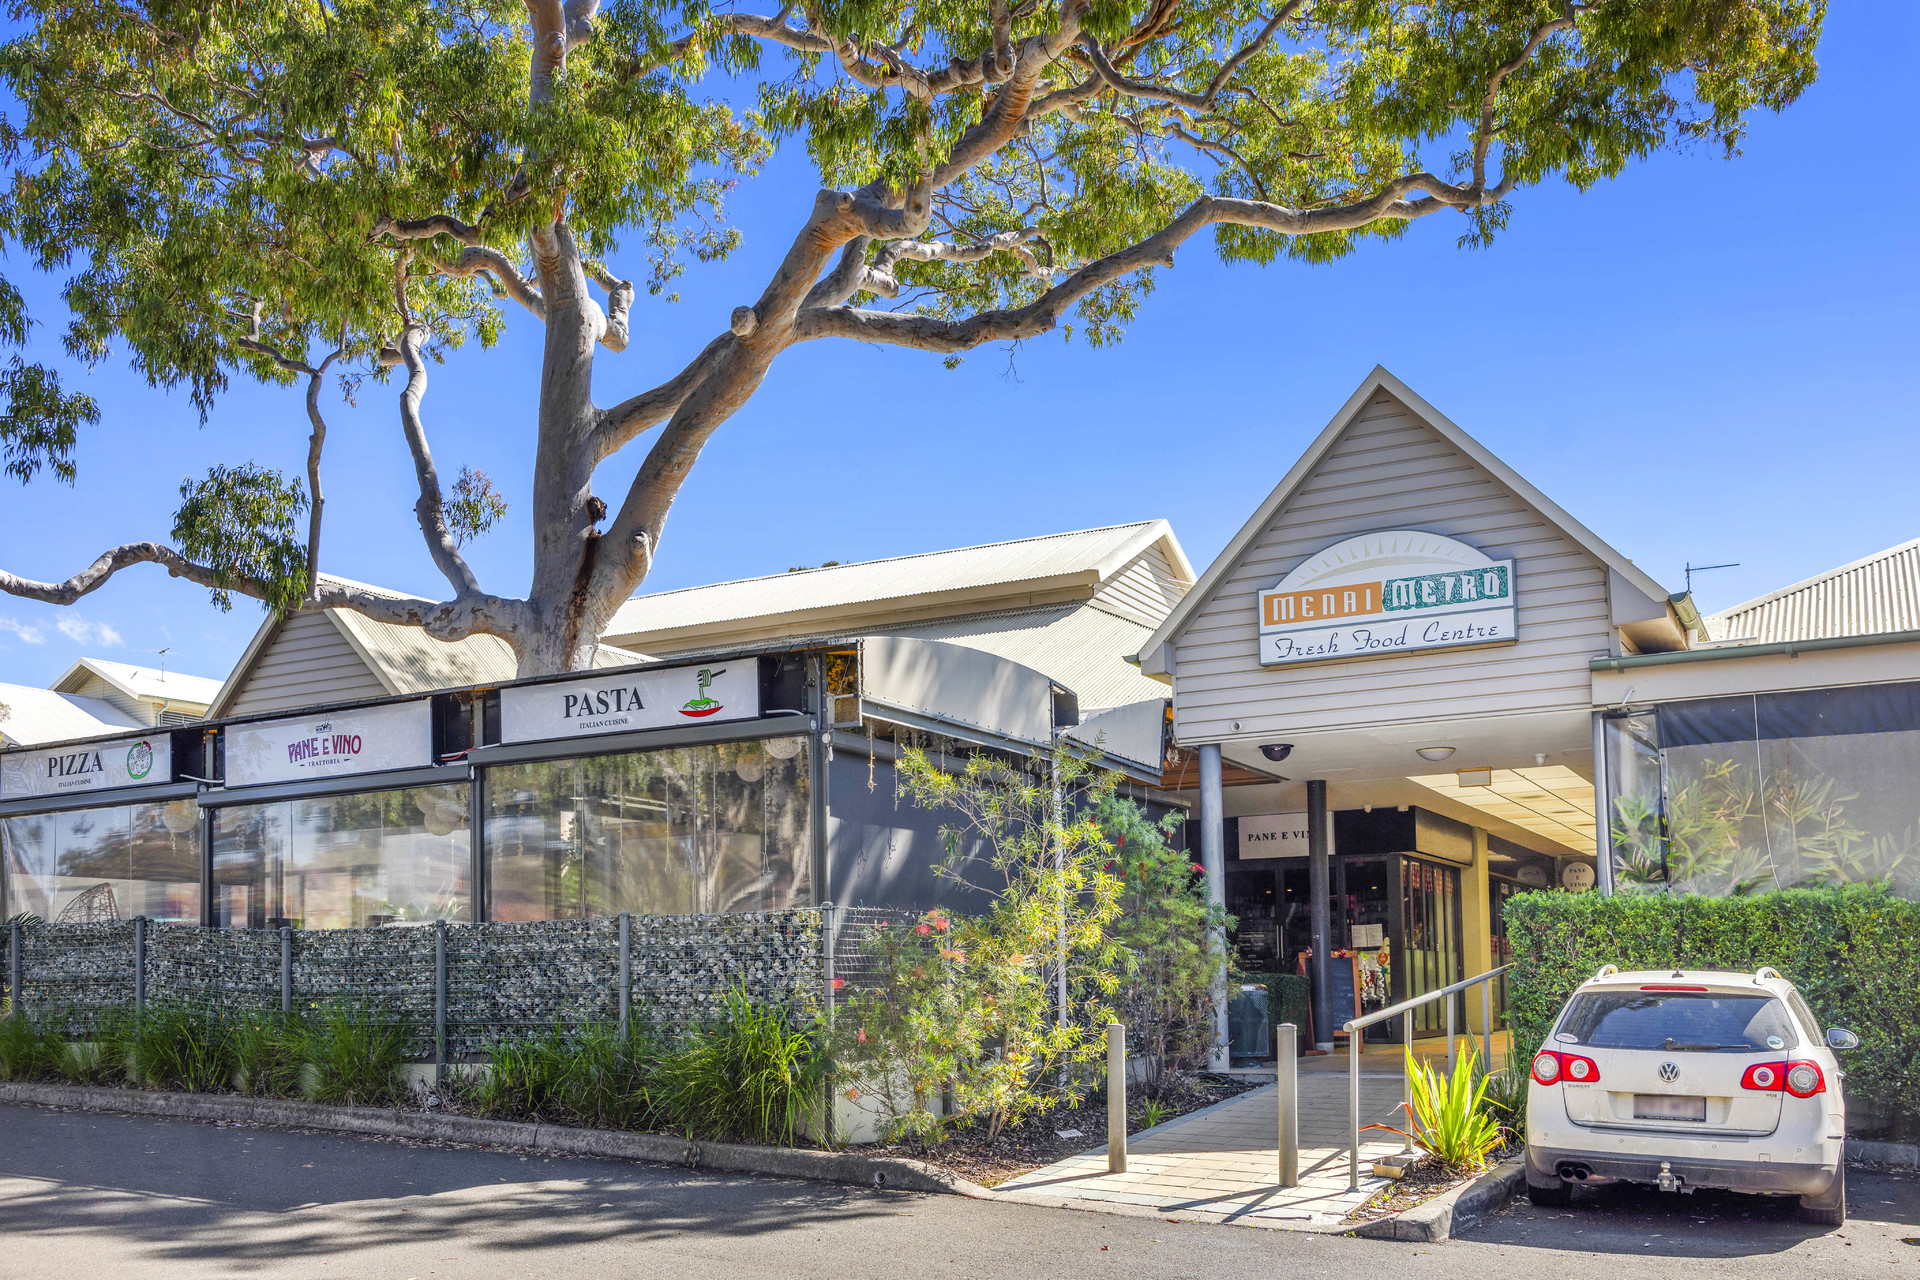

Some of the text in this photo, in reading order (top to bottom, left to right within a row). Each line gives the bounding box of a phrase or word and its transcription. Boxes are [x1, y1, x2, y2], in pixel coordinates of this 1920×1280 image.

[1273, 570, 1501, 621] MENAI METRO
[1275, 621, 1499, 659] Fresh Food Centre
[563, 686, 645, 719] PASTA
[579, 718, 629, 729] ITALIAN CUISINE
[287, 735, 362, 764] PANE E VINO
[307, 758, 340, 767] TRATTORIA
[47, 751, 104, 778] PIZZA
[58, 778, 92, 788] ITALIAN CUISINE
[1248, 832, 1277, 842] PANE
[1282, 831, 1288, 839] E
